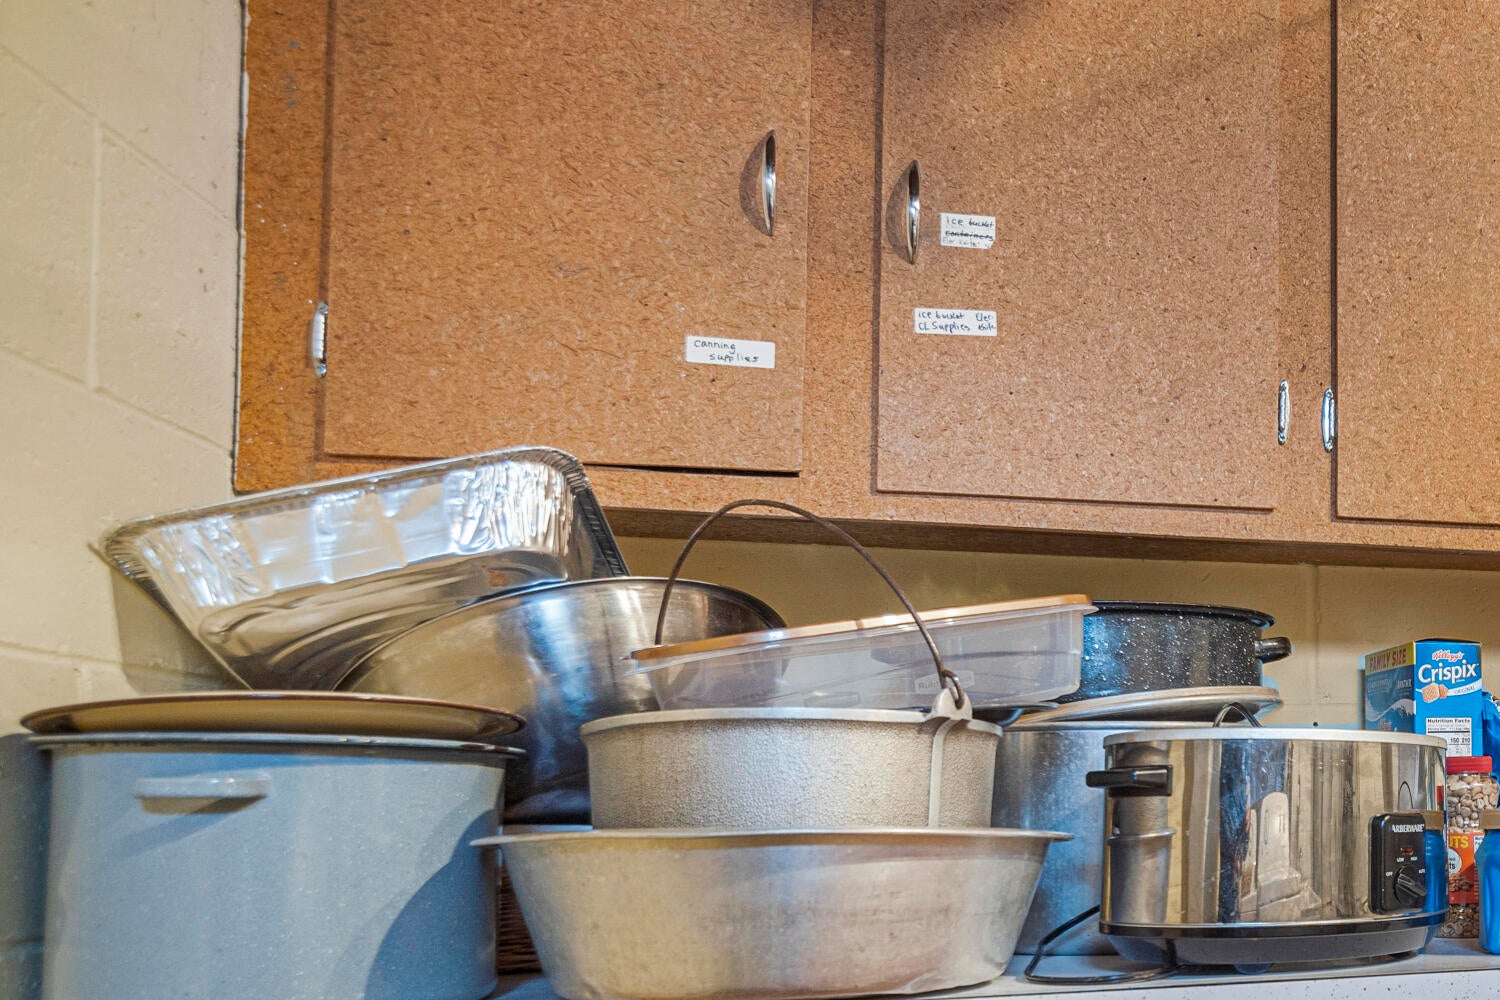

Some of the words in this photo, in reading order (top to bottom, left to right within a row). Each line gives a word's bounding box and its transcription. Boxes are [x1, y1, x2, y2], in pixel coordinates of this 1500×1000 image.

[918, 311, 932, 319] ice
[935, 311, 965, 320] bucket
[694, 339, 736, 355] canning
[709, 353, 760, 363] supplies
[1369, 652, 1391, 673] FAMILY
[1392, 648, 1407, 667] SIZE
[1432, 650, 1464, 662] Kellogg's
[1418, 660, 1478, 685] Crispix
[1454, 685, 1476, 695] ORIGINAL
